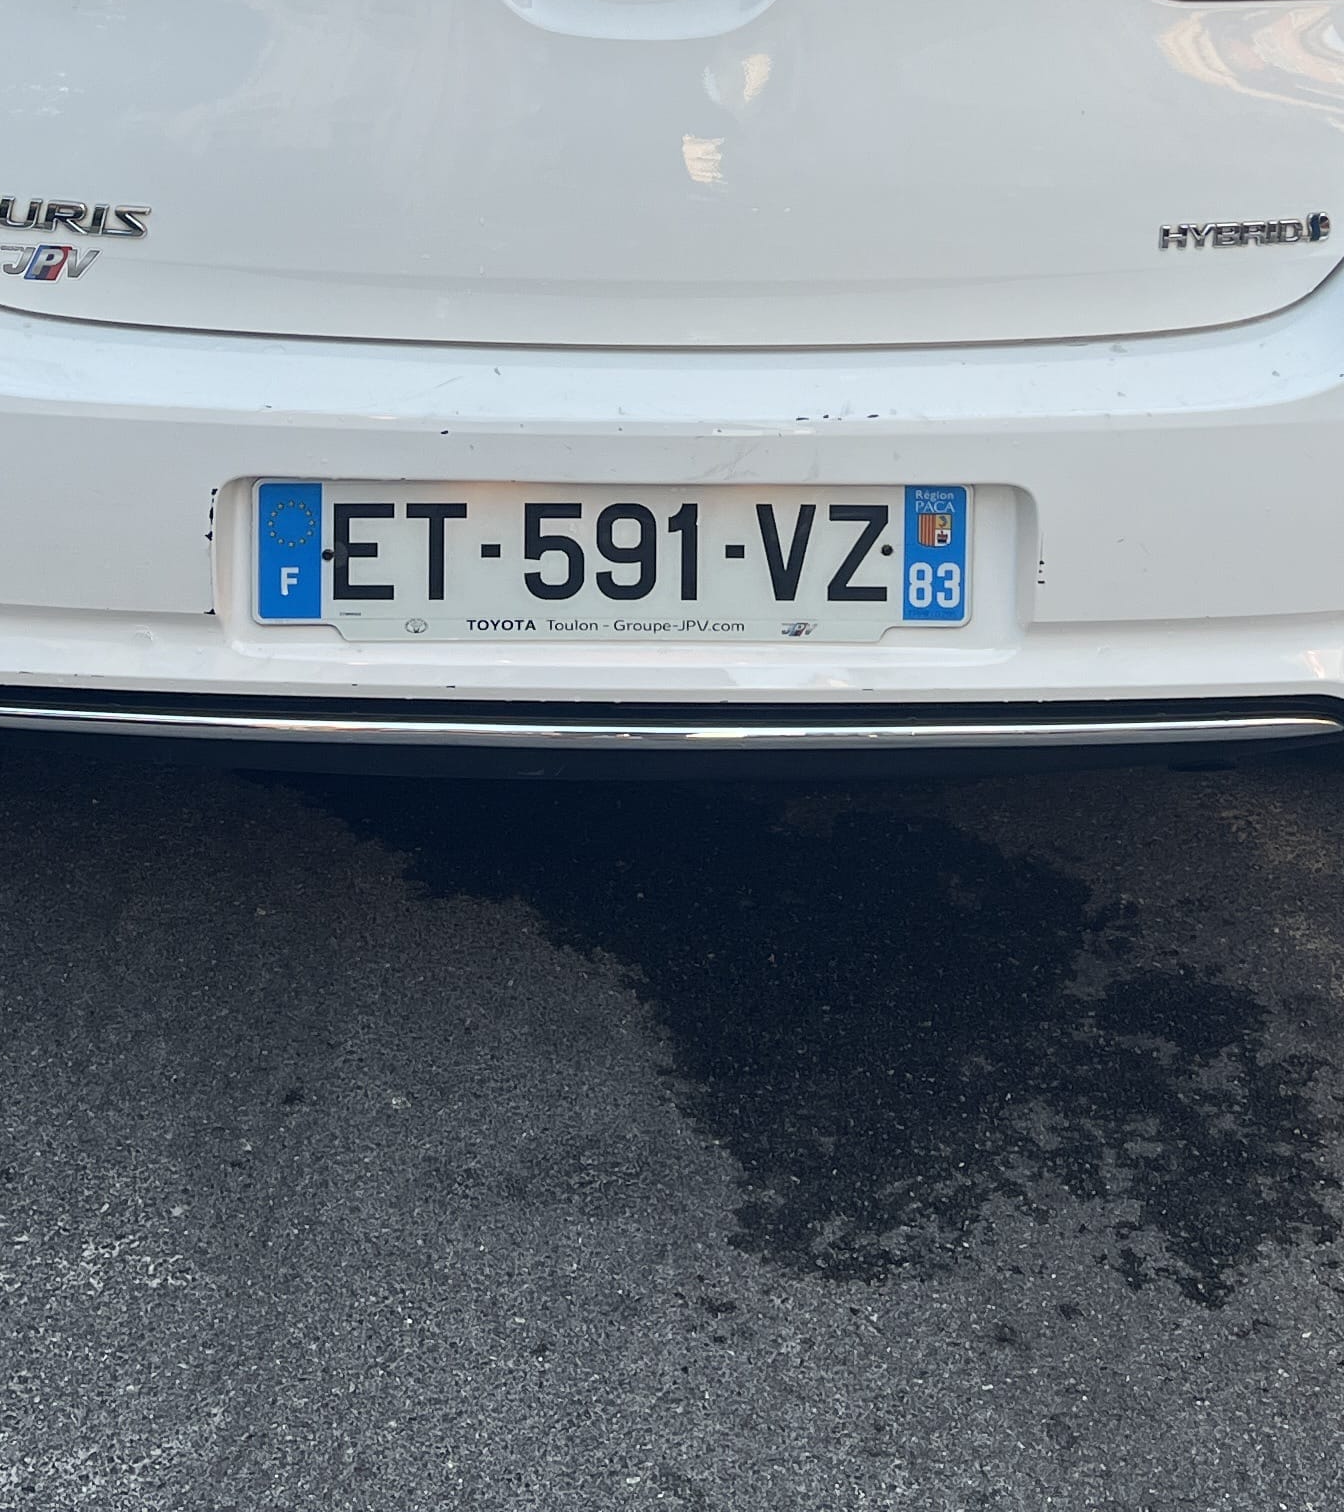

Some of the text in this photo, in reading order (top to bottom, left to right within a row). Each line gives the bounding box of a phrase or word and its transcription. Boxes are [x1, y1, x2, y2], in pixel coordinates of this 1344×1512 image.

[1159, 218, 1304, 250] HYBRID
[0, 244, 101, 283] JPV
[915, 489, 955, 505] Région
[915, 499, 957, 514] PACA
[279, 502, 962, 609] F ET-591-VZ 83
[467, 619, 537, 632] TOYOTA
[547, 618, 599, 632] Toulon
[613, 618, 745, 636] Groupe-JPV.com
